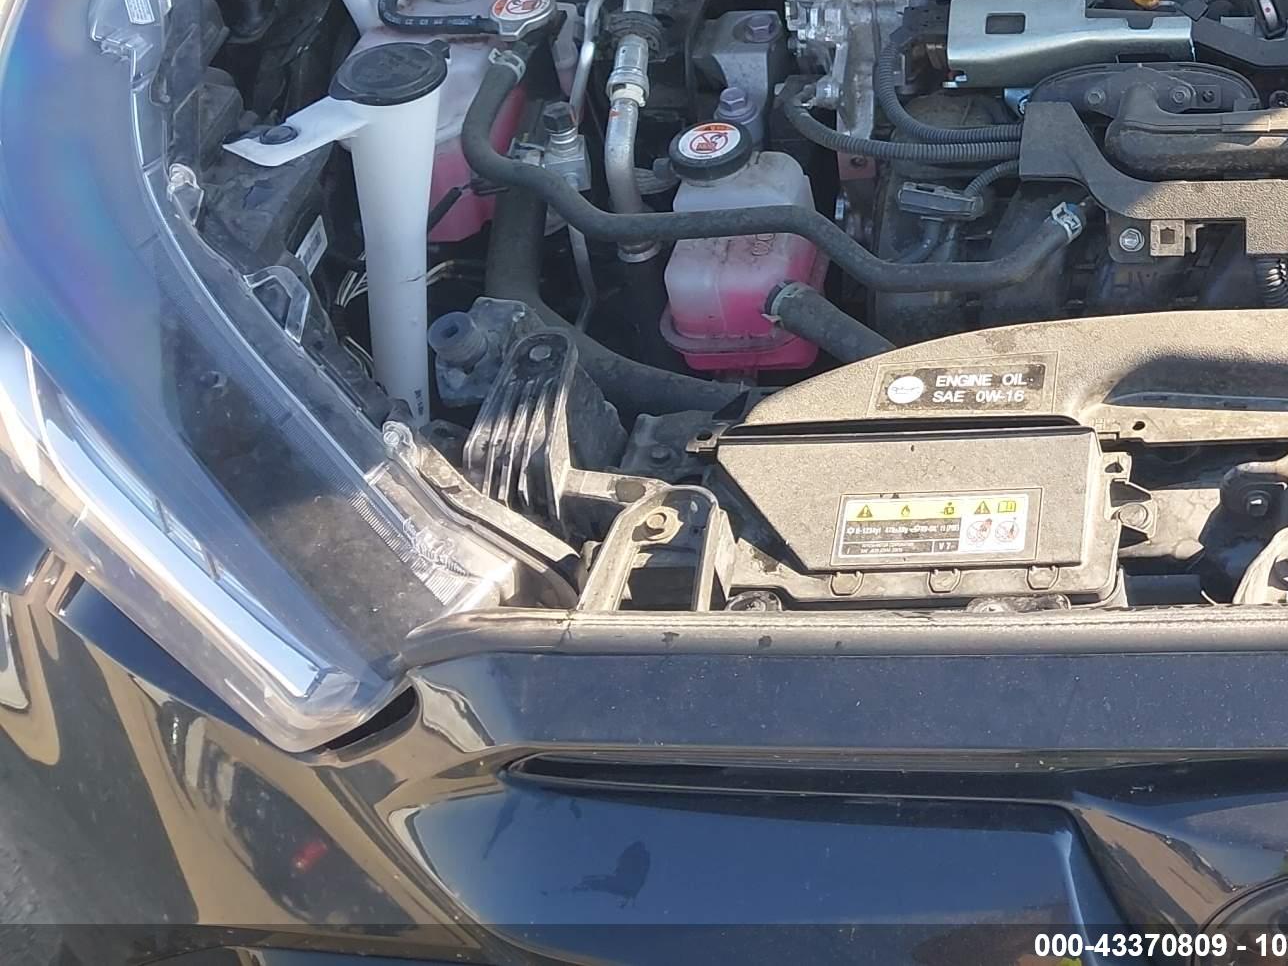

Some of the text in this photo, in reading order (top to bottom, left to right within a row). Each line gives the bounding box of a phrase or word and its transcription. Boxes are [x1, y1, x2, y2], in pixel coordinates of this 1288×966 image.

[935, 372, 1028, 388] ENGINE OIL
[932, 389, 1025, 403] SAE 0W-16
